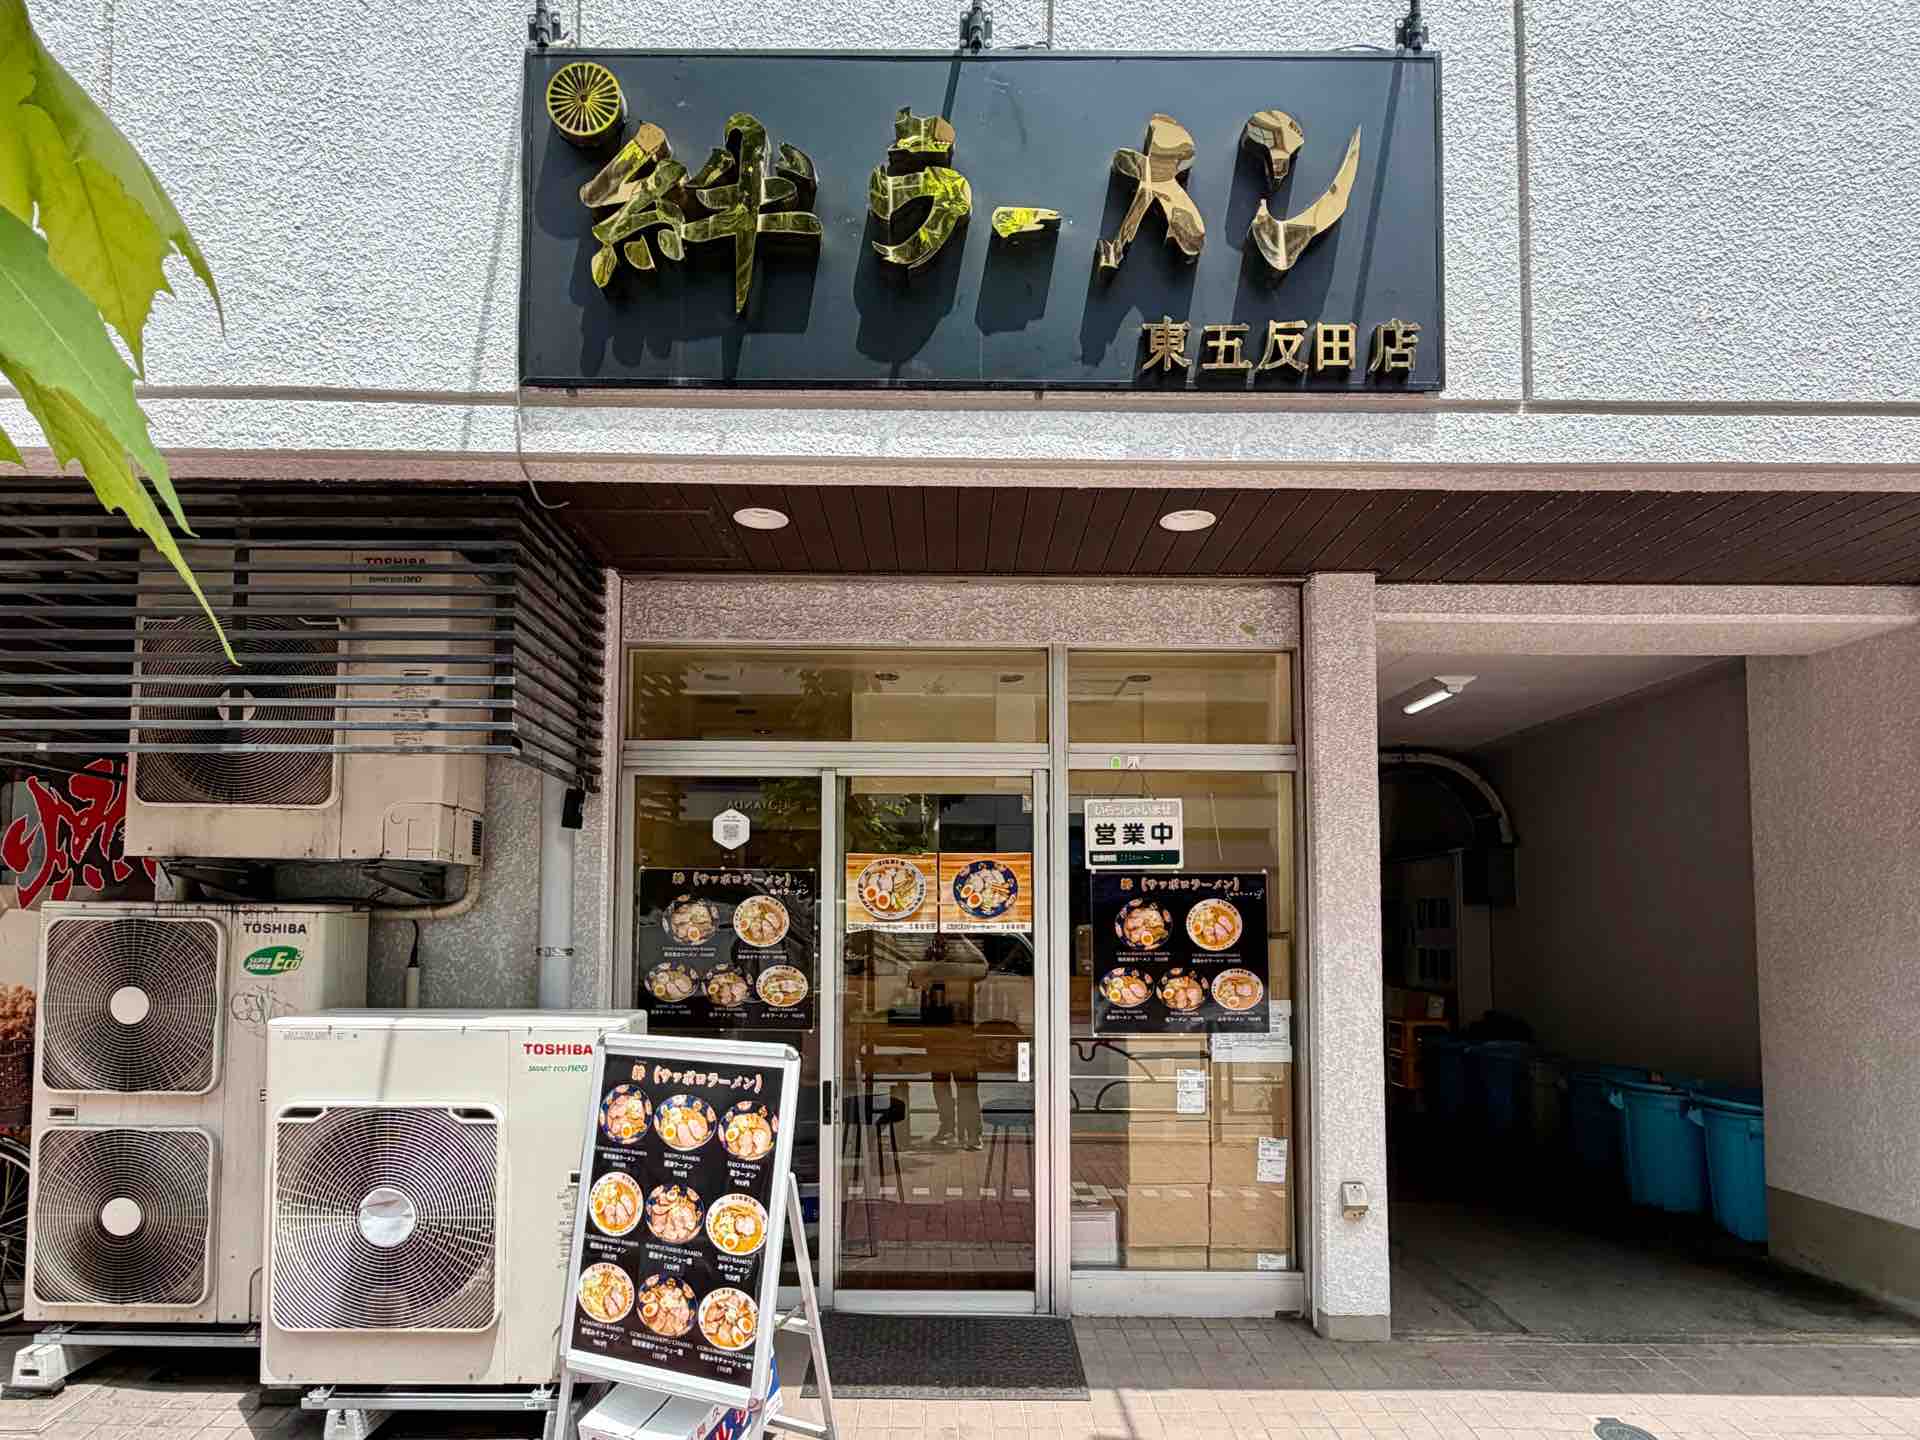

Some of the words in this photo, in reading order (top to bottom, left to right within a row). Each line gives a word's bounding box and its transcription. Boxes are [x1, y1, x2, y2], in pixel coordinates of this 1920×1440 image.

[1142, 317, 1421, 374] 東五反田店
[1094, 822, 1174, 845] 営業中
[243, 923, 306, 934] TOSHIBA
[523, 1043, 593, 1055] TOSHIBA
